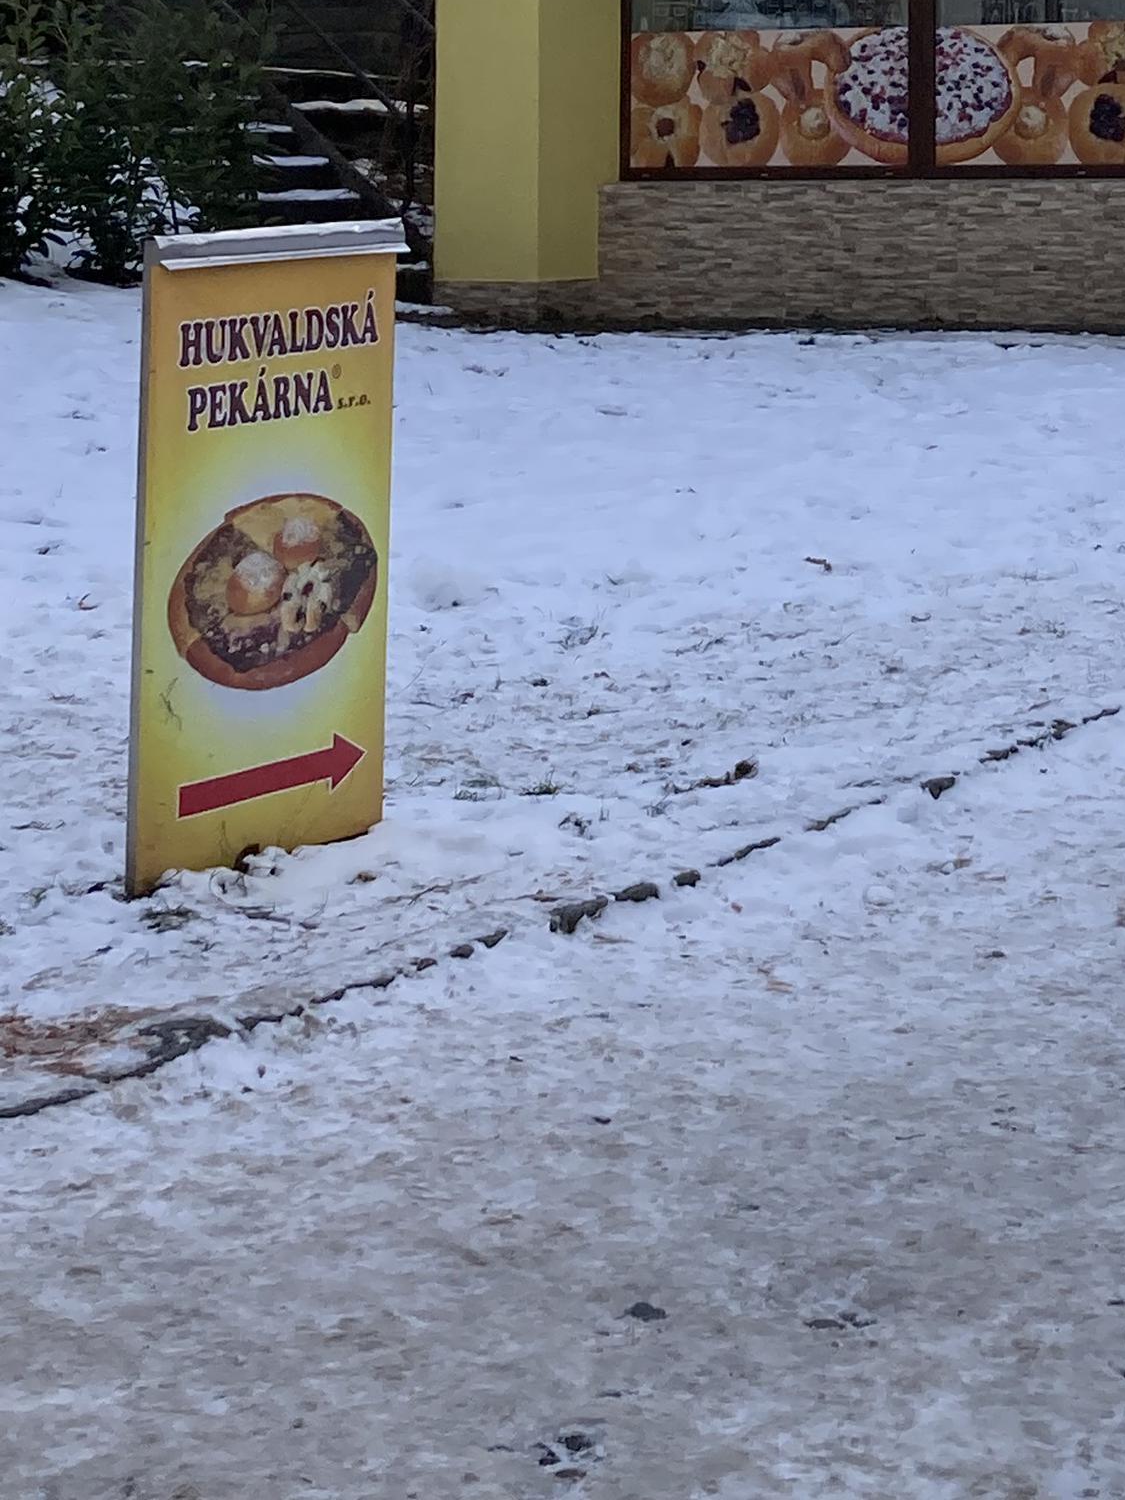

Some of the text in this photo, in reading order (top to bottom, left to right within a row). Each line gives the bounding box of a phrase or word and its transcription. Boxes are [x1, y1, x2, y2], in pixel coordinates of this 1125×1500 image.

[179, 290, 379, 367] HUKVALDSKÁ
[187, 367, 371, 431] PEKÁRNA s.r.o.
